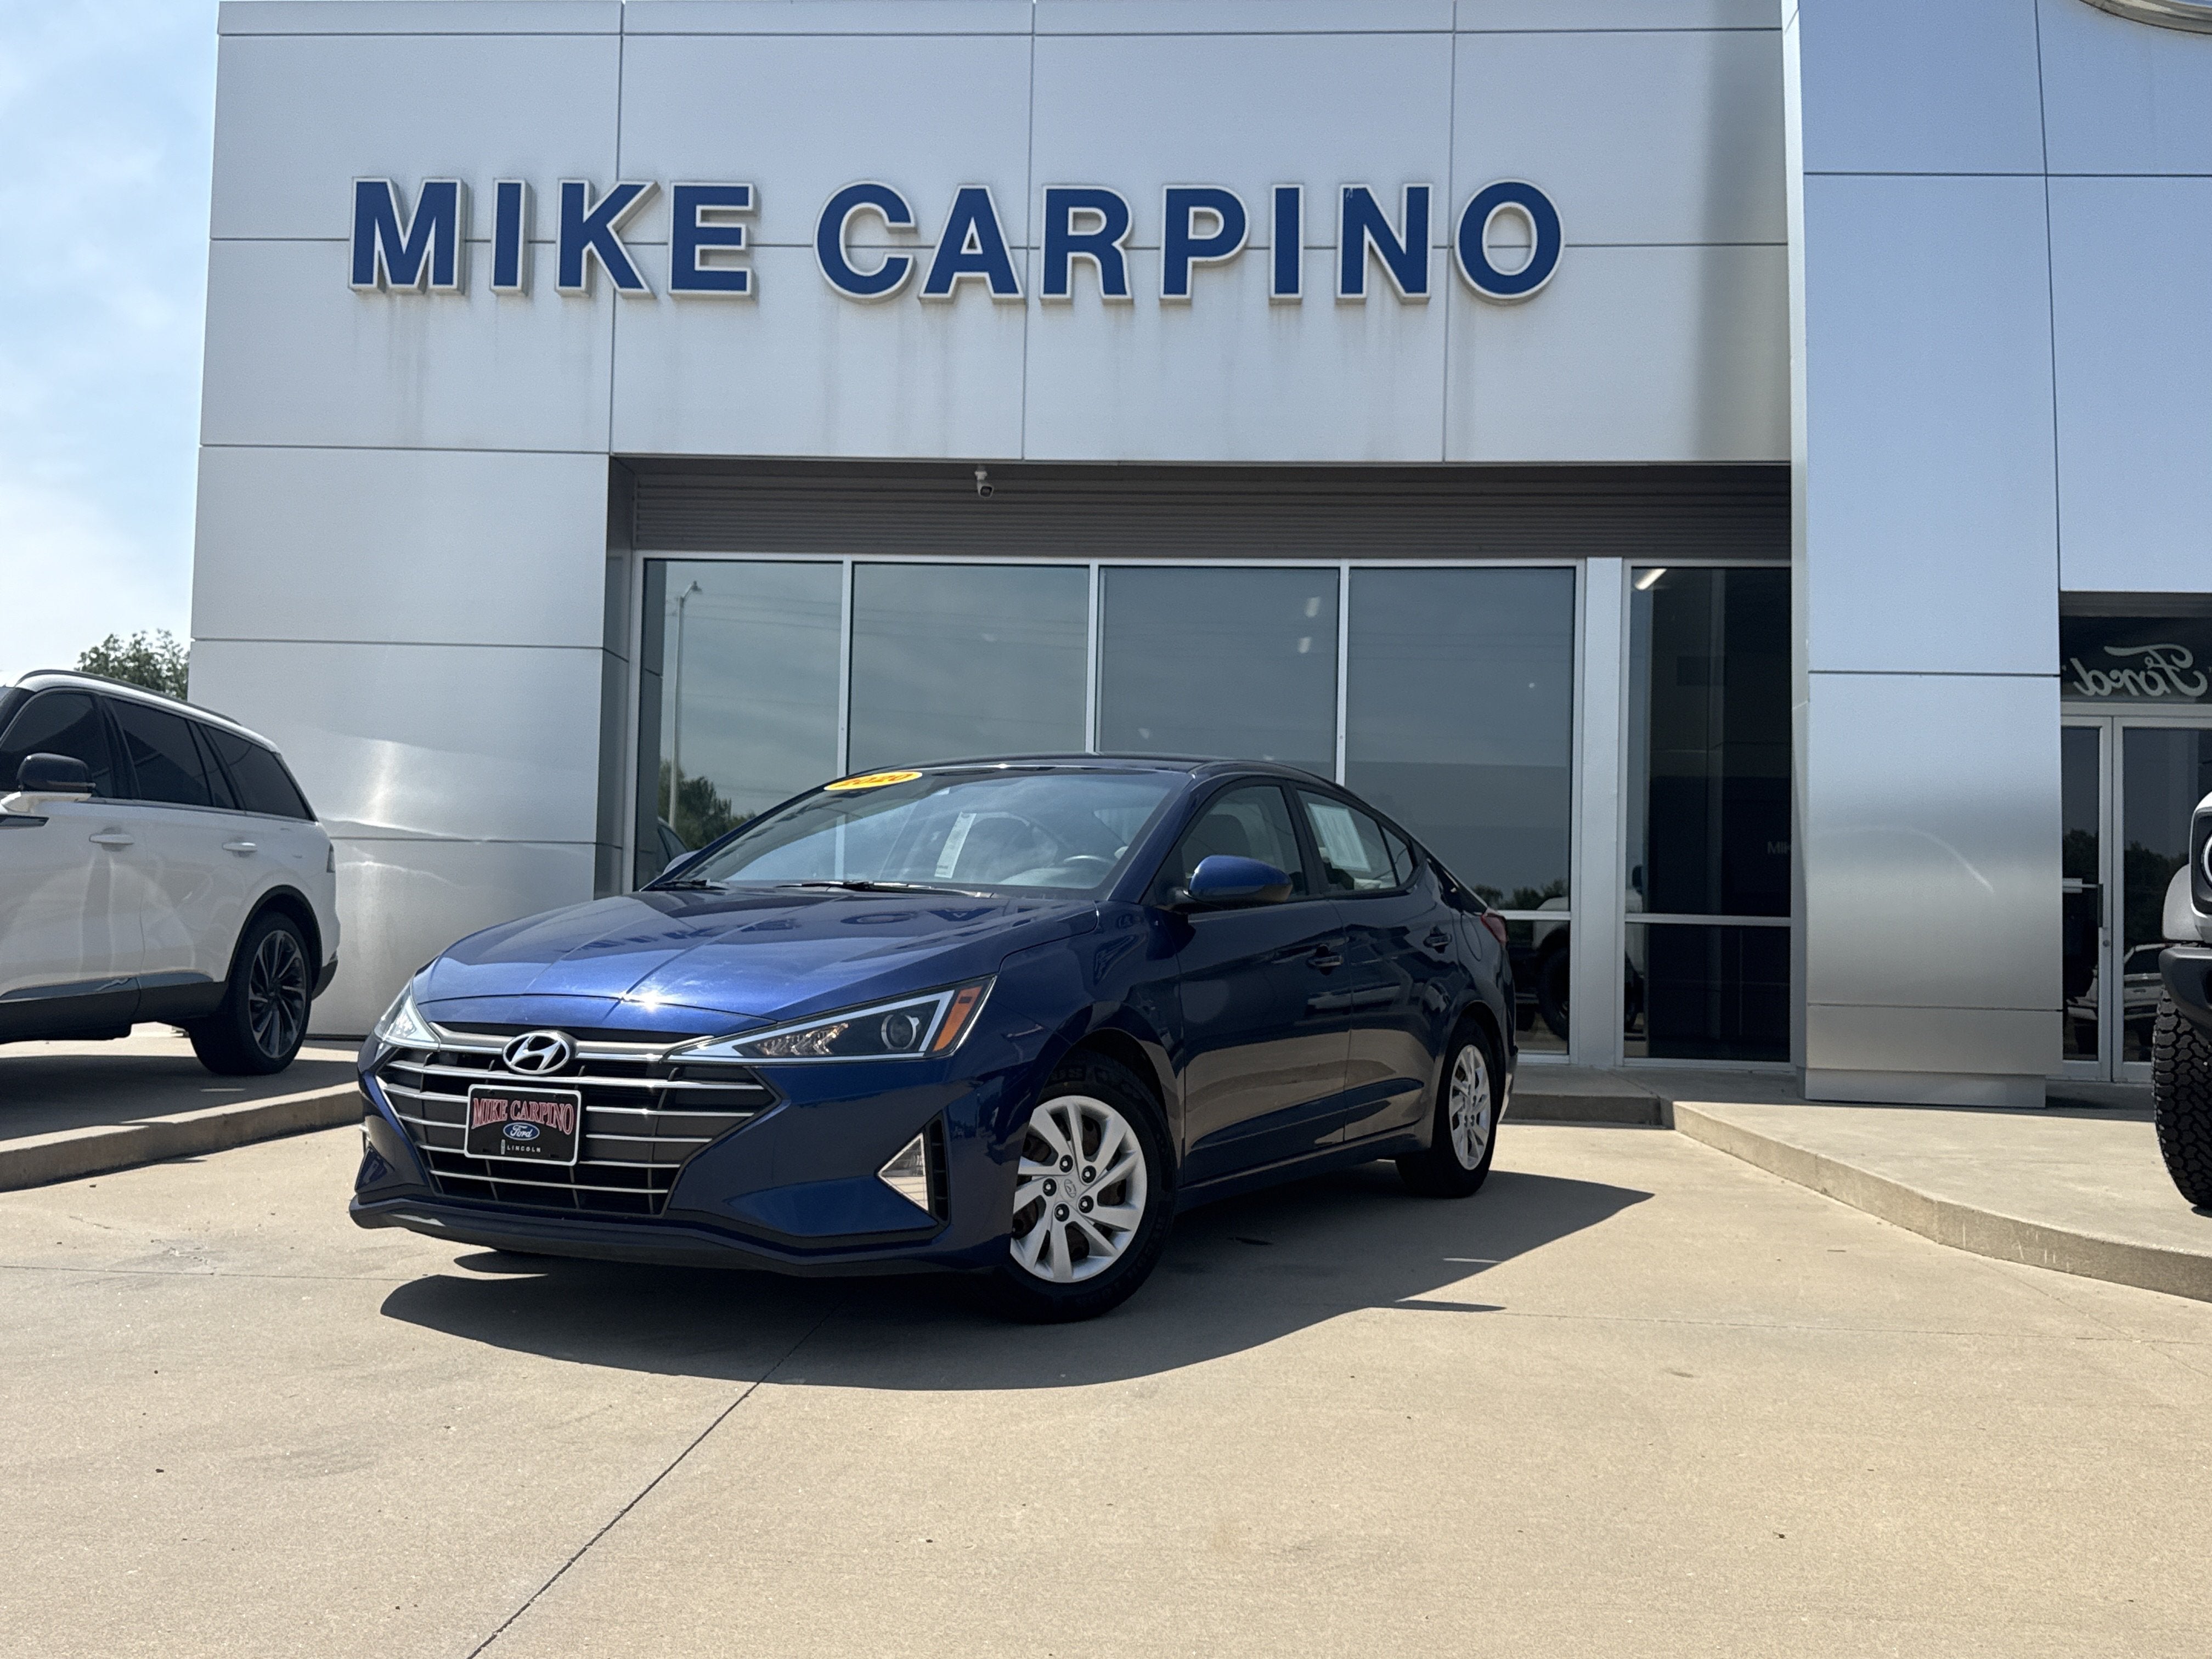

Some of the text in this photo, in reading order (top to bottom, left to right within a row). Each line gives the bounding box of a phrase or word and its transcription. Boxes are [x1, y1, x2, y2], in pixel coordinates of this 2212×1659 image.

[349, 177, 1566, 303] MIKE CARPINO
[471, 1098, 574, 1135] MIKE CARPINO
[510, 1124, 533, 1138] Ford
